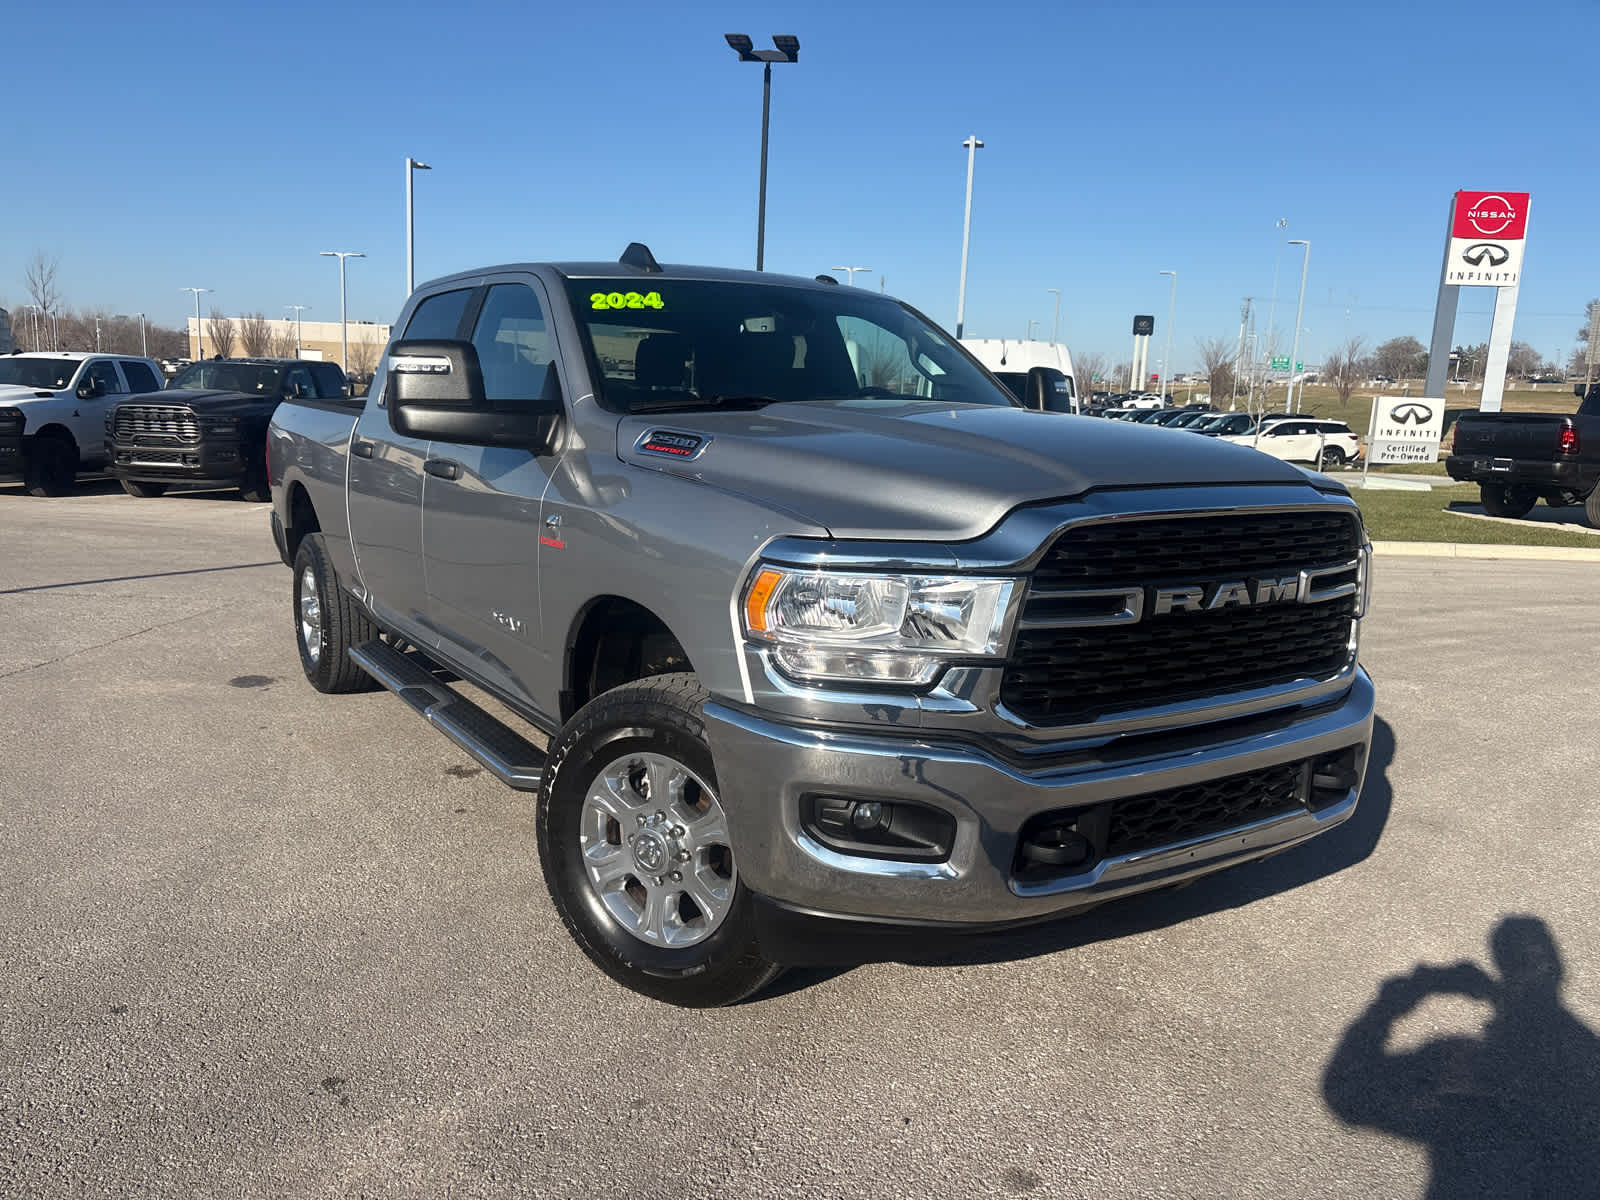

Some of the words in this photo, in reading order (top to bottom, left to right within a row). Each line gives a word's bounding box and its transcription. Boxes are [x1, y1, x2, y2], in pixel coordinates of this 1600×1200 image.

[1467, 210, 1516, 219] NISSAN
[1449, 271, 1516, 282] INFINITI
[590, 291, 665, 310] 2024
[1380, 428, 1437, 438] INFINITI
[1386, 444, 1426, 453] Certified
[1380, 452, 1430, 461] Pre-Owned
[1154, 576, 1299, 616] RAM
